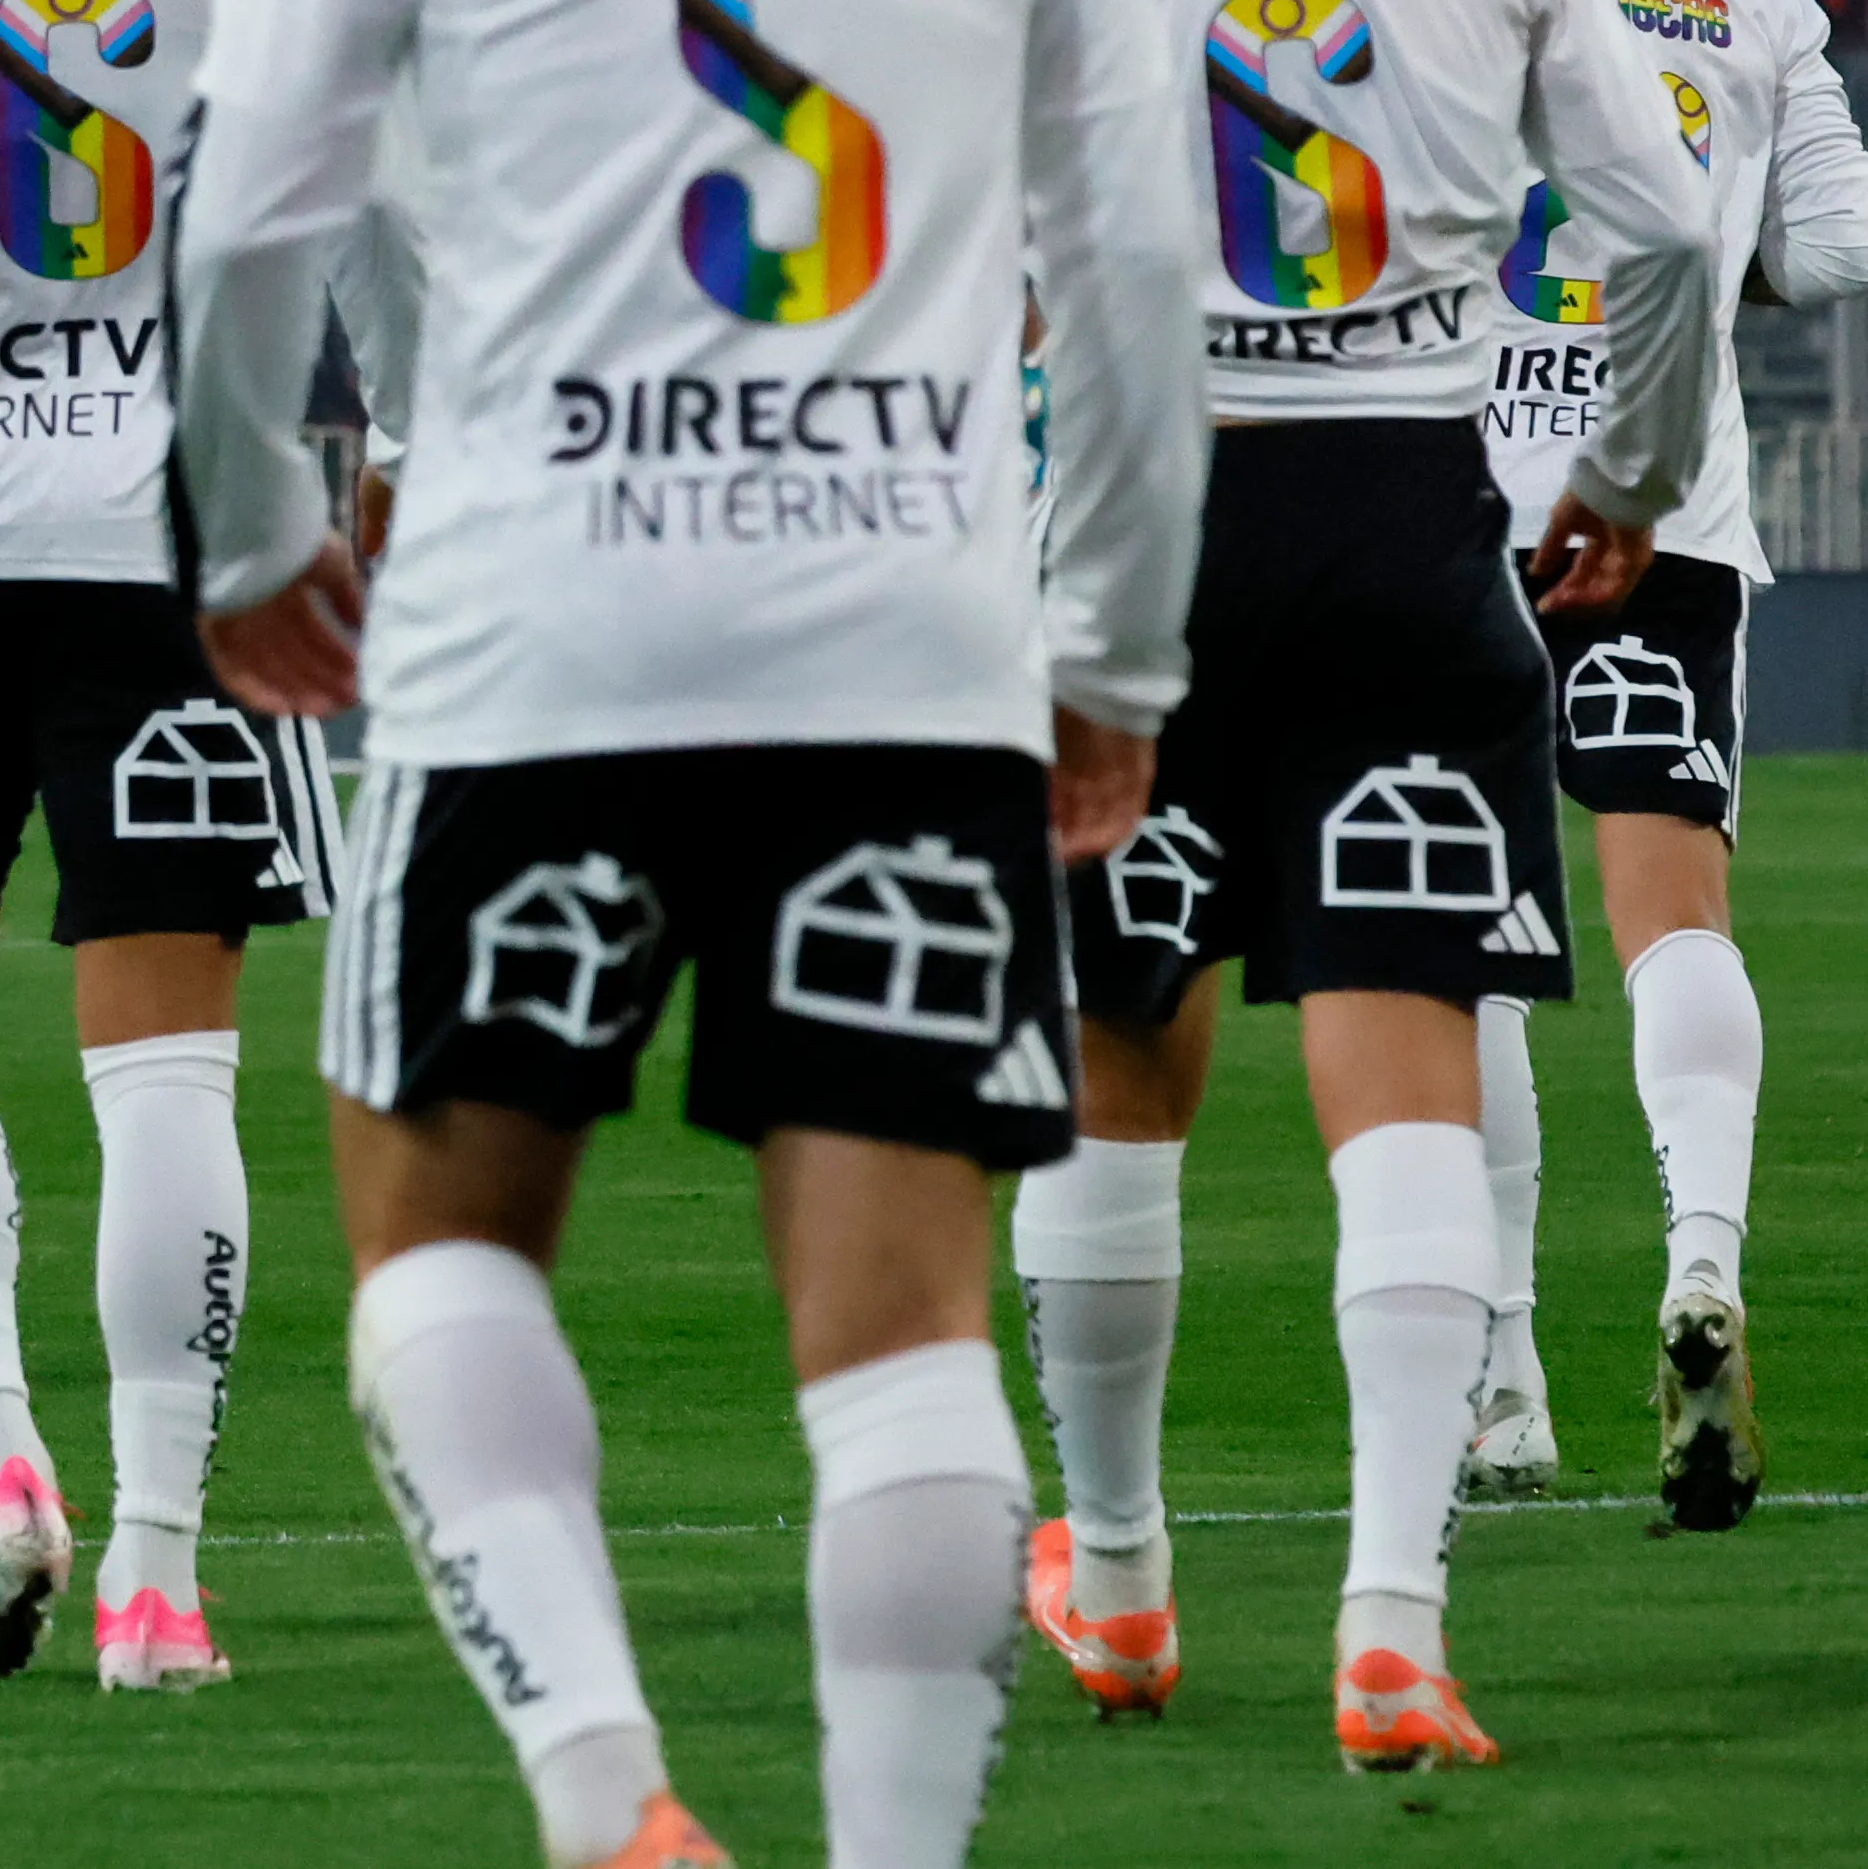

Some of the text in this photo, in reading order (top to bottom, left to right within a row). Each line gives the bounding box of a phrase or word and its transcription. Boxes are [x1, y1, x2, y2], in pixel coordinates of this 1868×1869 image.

[1207, 287, 1467, 362] RECTV
[1495, 345, 1612, 397] IRE
[548, 373, 974, 463] DIRECTV
[584, 466, 974, 549] INTERNET
